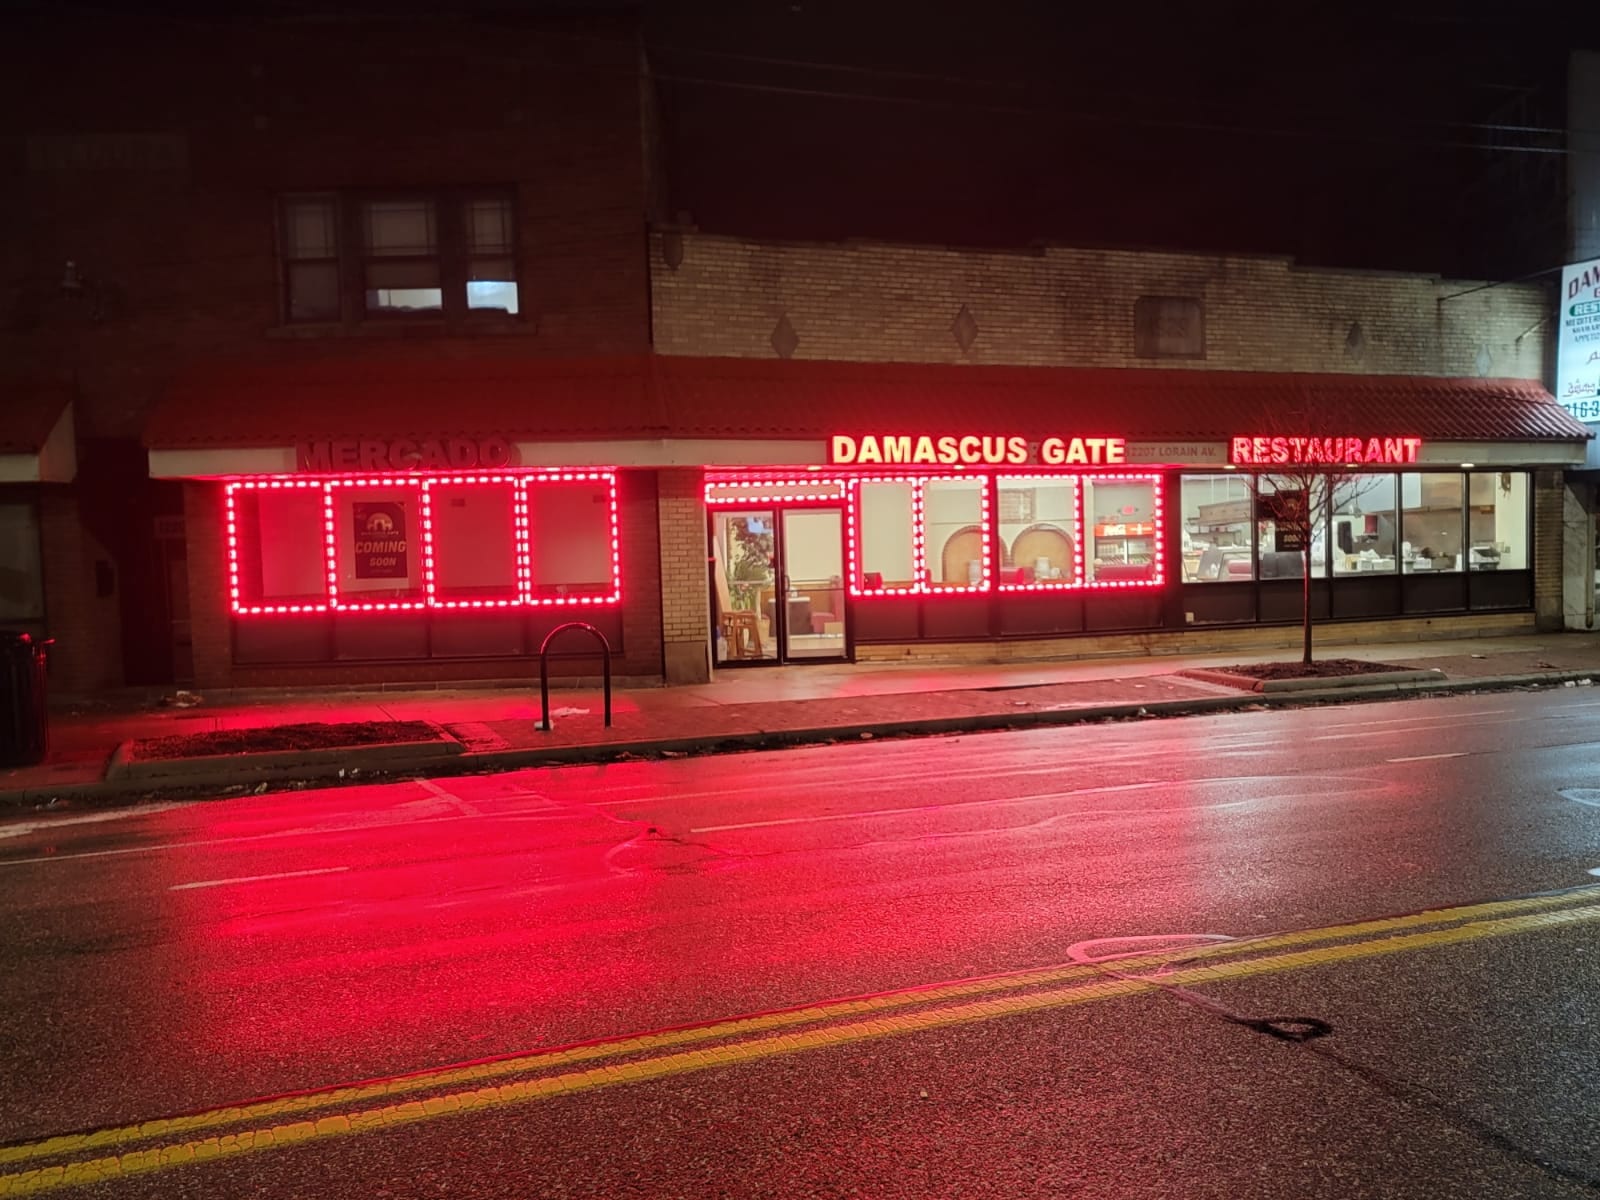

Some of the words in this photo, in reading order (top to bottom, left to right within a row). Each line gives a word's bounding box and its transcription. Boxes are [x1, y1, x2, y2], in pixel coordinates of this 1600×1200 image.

[298, 440, 514, 472] MERCADO
[832, 435, 1027, 464] DAMASCUS
[1041, 438, 1125, 464] GATE
[1159, 447, 1198, 457] LORAIN
[1232, 437, 1422, 464] RESTAURANT
[355, 540, 407, 554] COMING
[369, 556, 397, 567] SOON
